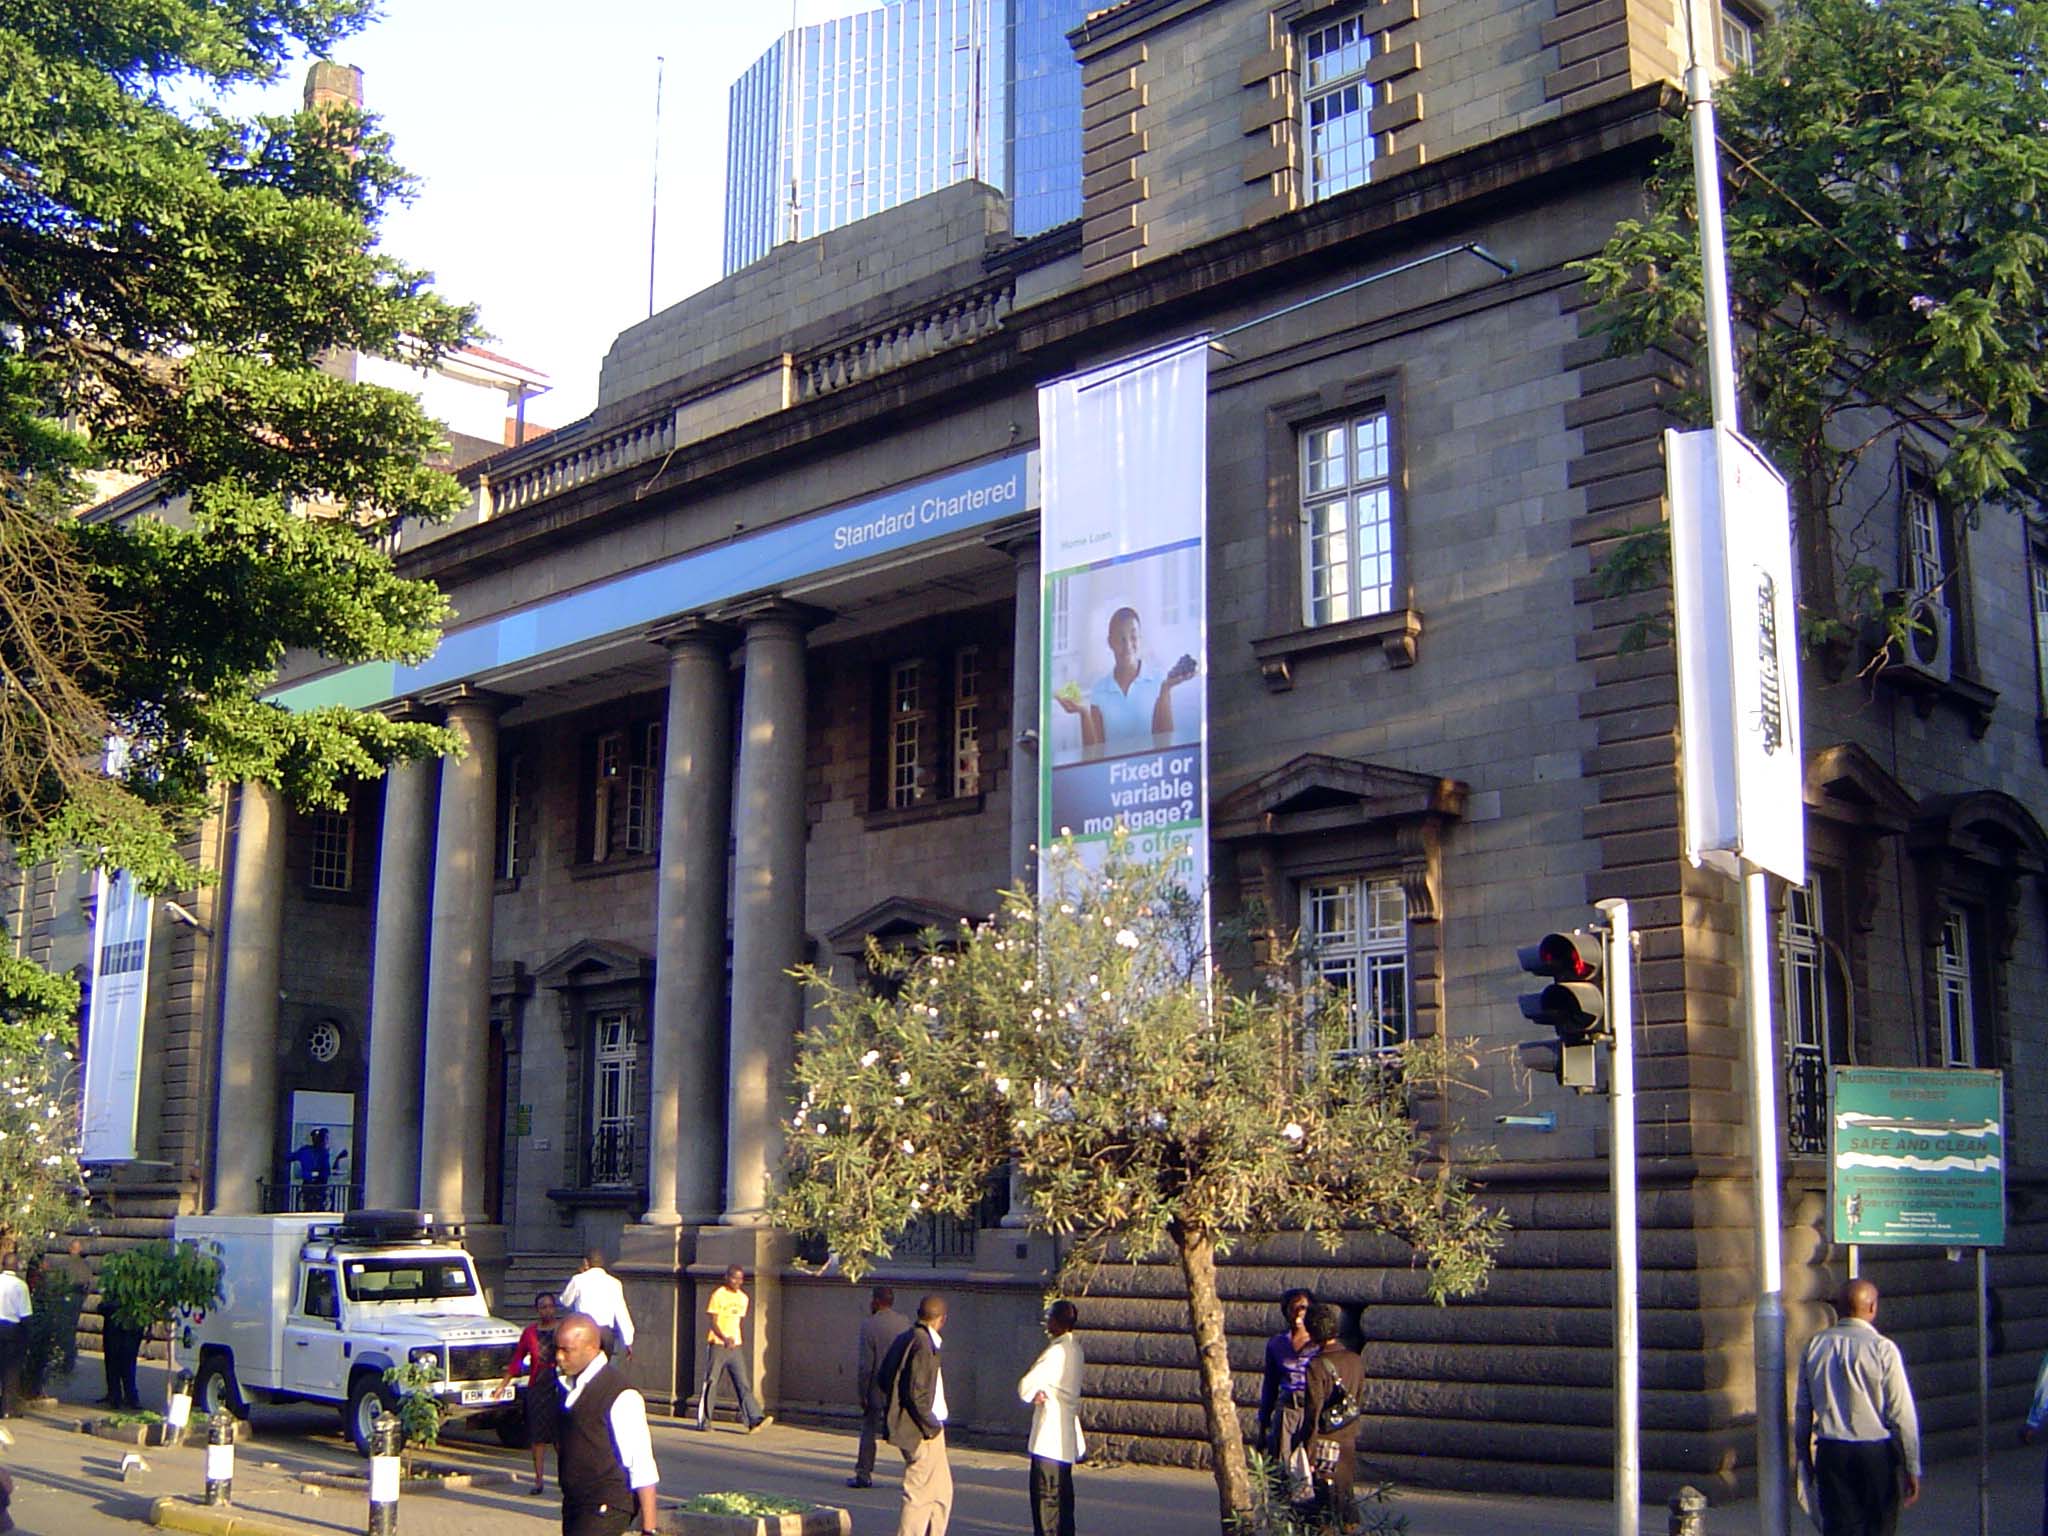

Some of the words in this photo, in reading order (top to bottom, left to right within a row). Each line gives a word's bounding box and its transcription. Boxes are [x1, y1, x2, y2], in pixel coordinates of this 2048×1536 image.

[834, 505, 915, 549] Standard
[920, 474, 1016, 524] Chartered
[1089, 531, 1112, 544] Loan
[1110, 757, 1163, 784] Fixed
[1170, 757, 1193, 774] or
[1111, 778, 1193, 807] variable
[1084, 799, 1194, 834] motgage?
[1850, 1137, 1889, 1150] SAFE
[1896, 1138, 1929, 1150] AND
[1935, 1139, 1988, 1151] CLEAN
